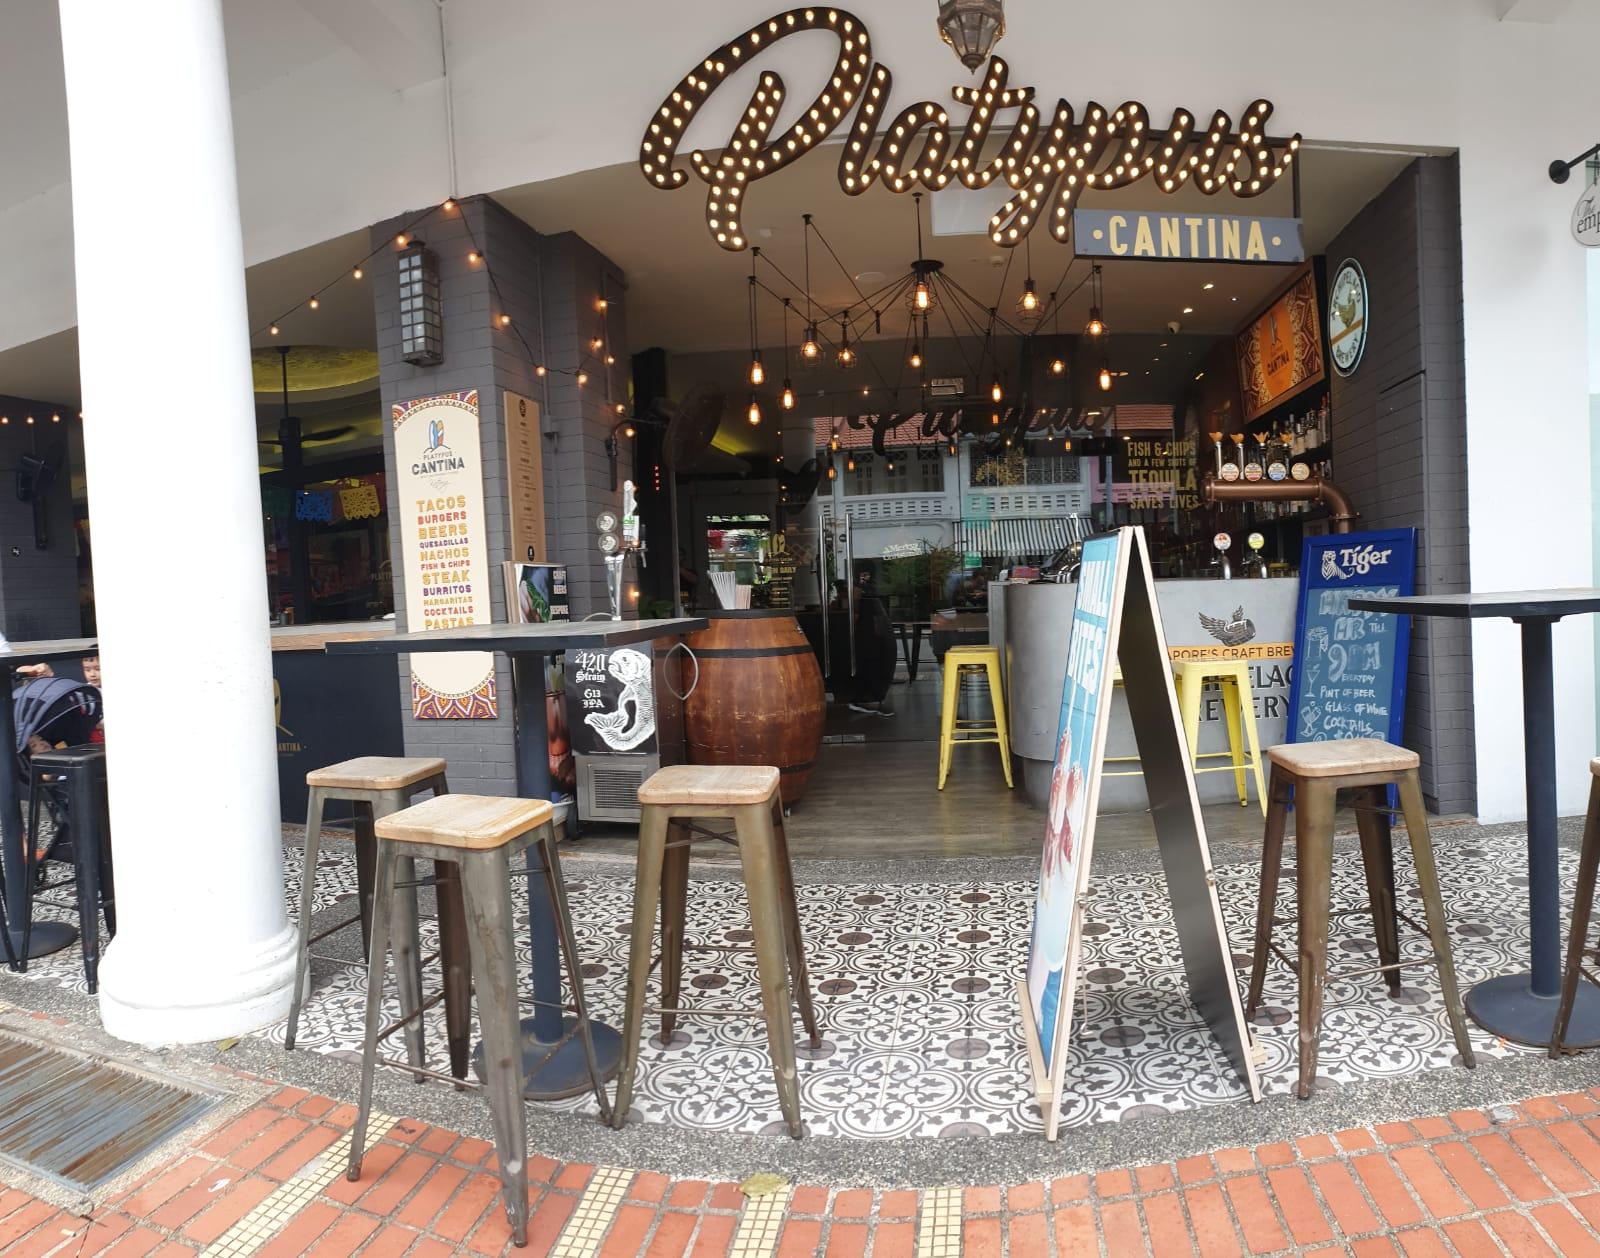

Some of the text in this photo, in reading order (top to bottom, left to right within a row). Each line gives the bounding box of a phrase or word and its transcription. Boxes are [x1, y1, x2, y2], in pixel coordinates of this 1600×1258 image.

[640, 6, 1303, 251] Platypus
[1109, 215, 1268, 261] CANTINA
[1127, 441, 1151, 457] FISH
[1166, 441, 1196, 457] CHIPS
[411, 457, 465, 475] CANTINA
[1128, 467, 1198, 492] TEQUILA
[416, 495, 466, 512] TACOS
[417, 511, 467, 525] BURGERS
[418, 522, 468, 539] BEERS
[419, 537, 469, 549] QUESADILLAS
[420, 546, 470, 561] NACHOS
[1340, 545, 1392, 574] Tiger
[422, 569, 471, 586] STEAK
[423, 584, 472, 597] BURRITOS
[424, 596, 473, 606] MARGARITAS
[424, 606, 474, 616] COCKTAILS
[1222, 647, 1263, 659] CRAFT
[575, 651, 608, 673] 420
[575, 668, 606, 684] Strain
[1320, 685, 1340, 698] PINT
[1353, 688, 1376, 698] BEER
[1323, 714, 1374, 734] COCKTAILS
